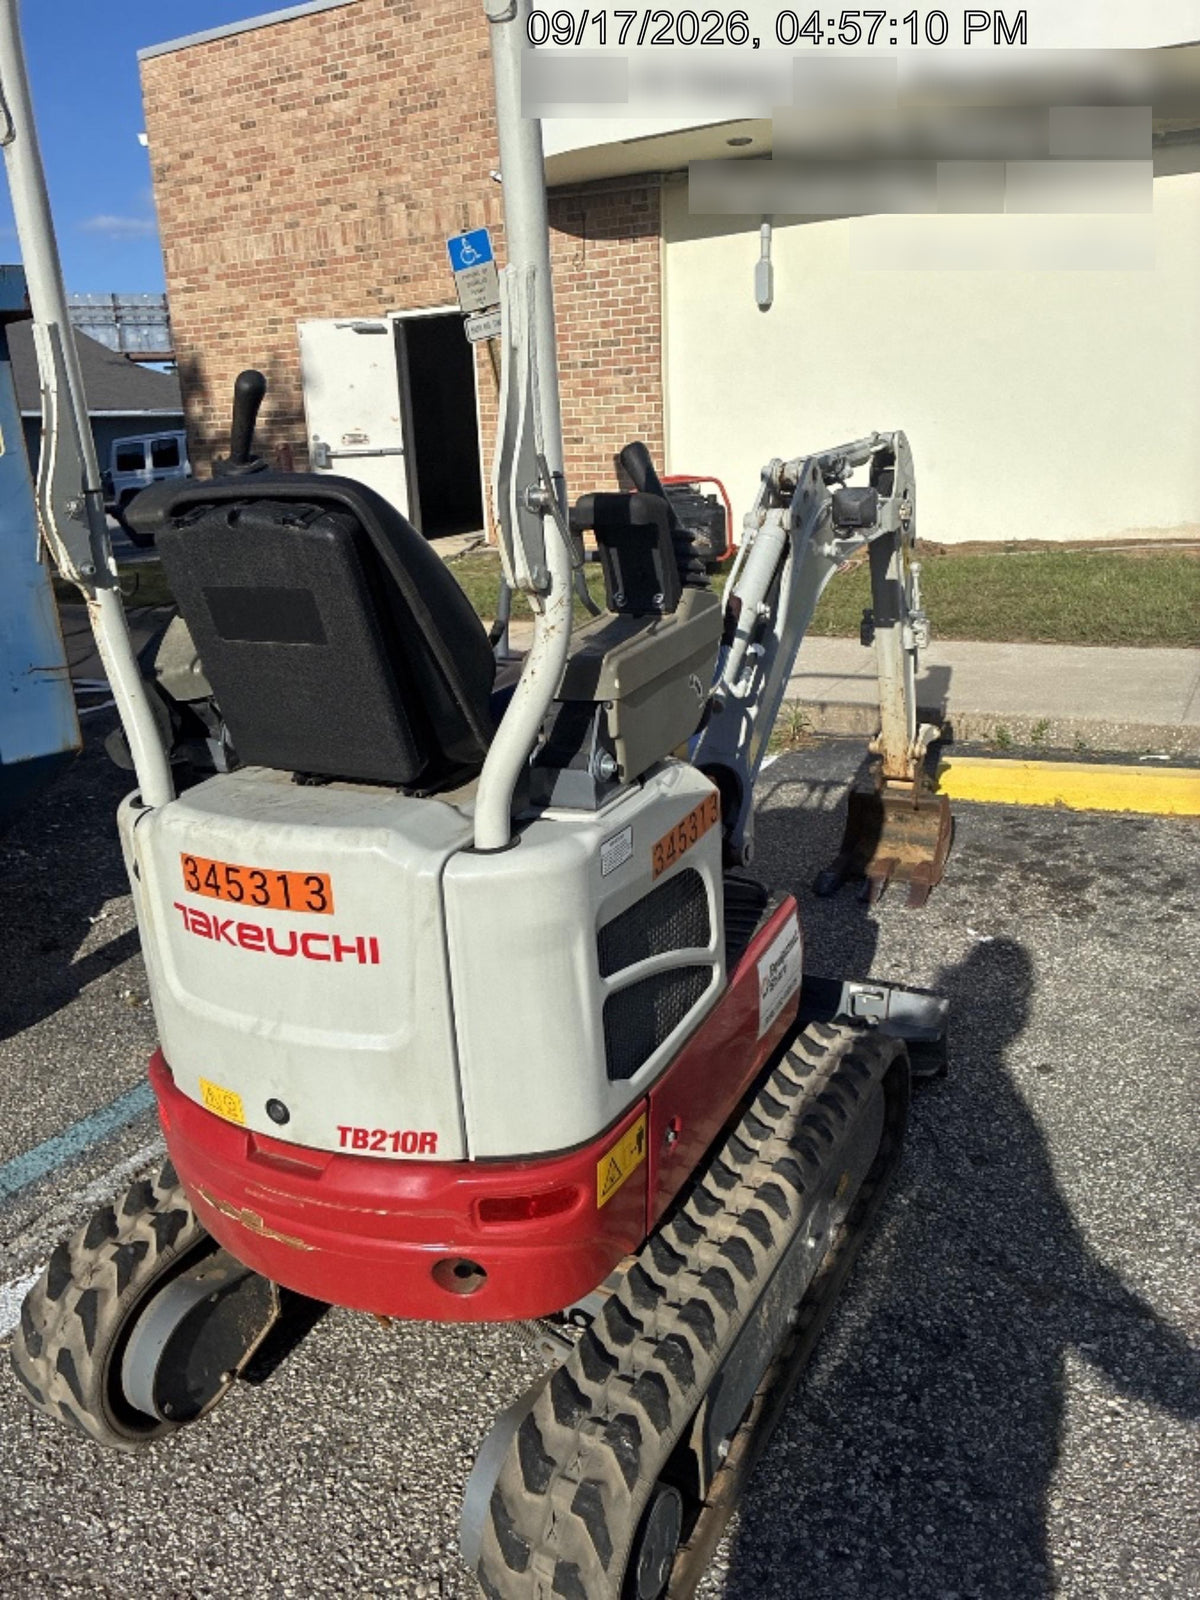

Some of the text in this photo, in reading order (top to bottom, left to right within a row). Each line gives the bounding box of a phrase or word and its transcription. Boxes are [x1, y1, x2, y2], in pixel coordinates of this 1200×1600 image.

[655, 792, 717, 876] 345313
[184, 855, 328, 913] 345313
[336, 1125, 439, 1154] TB210R
